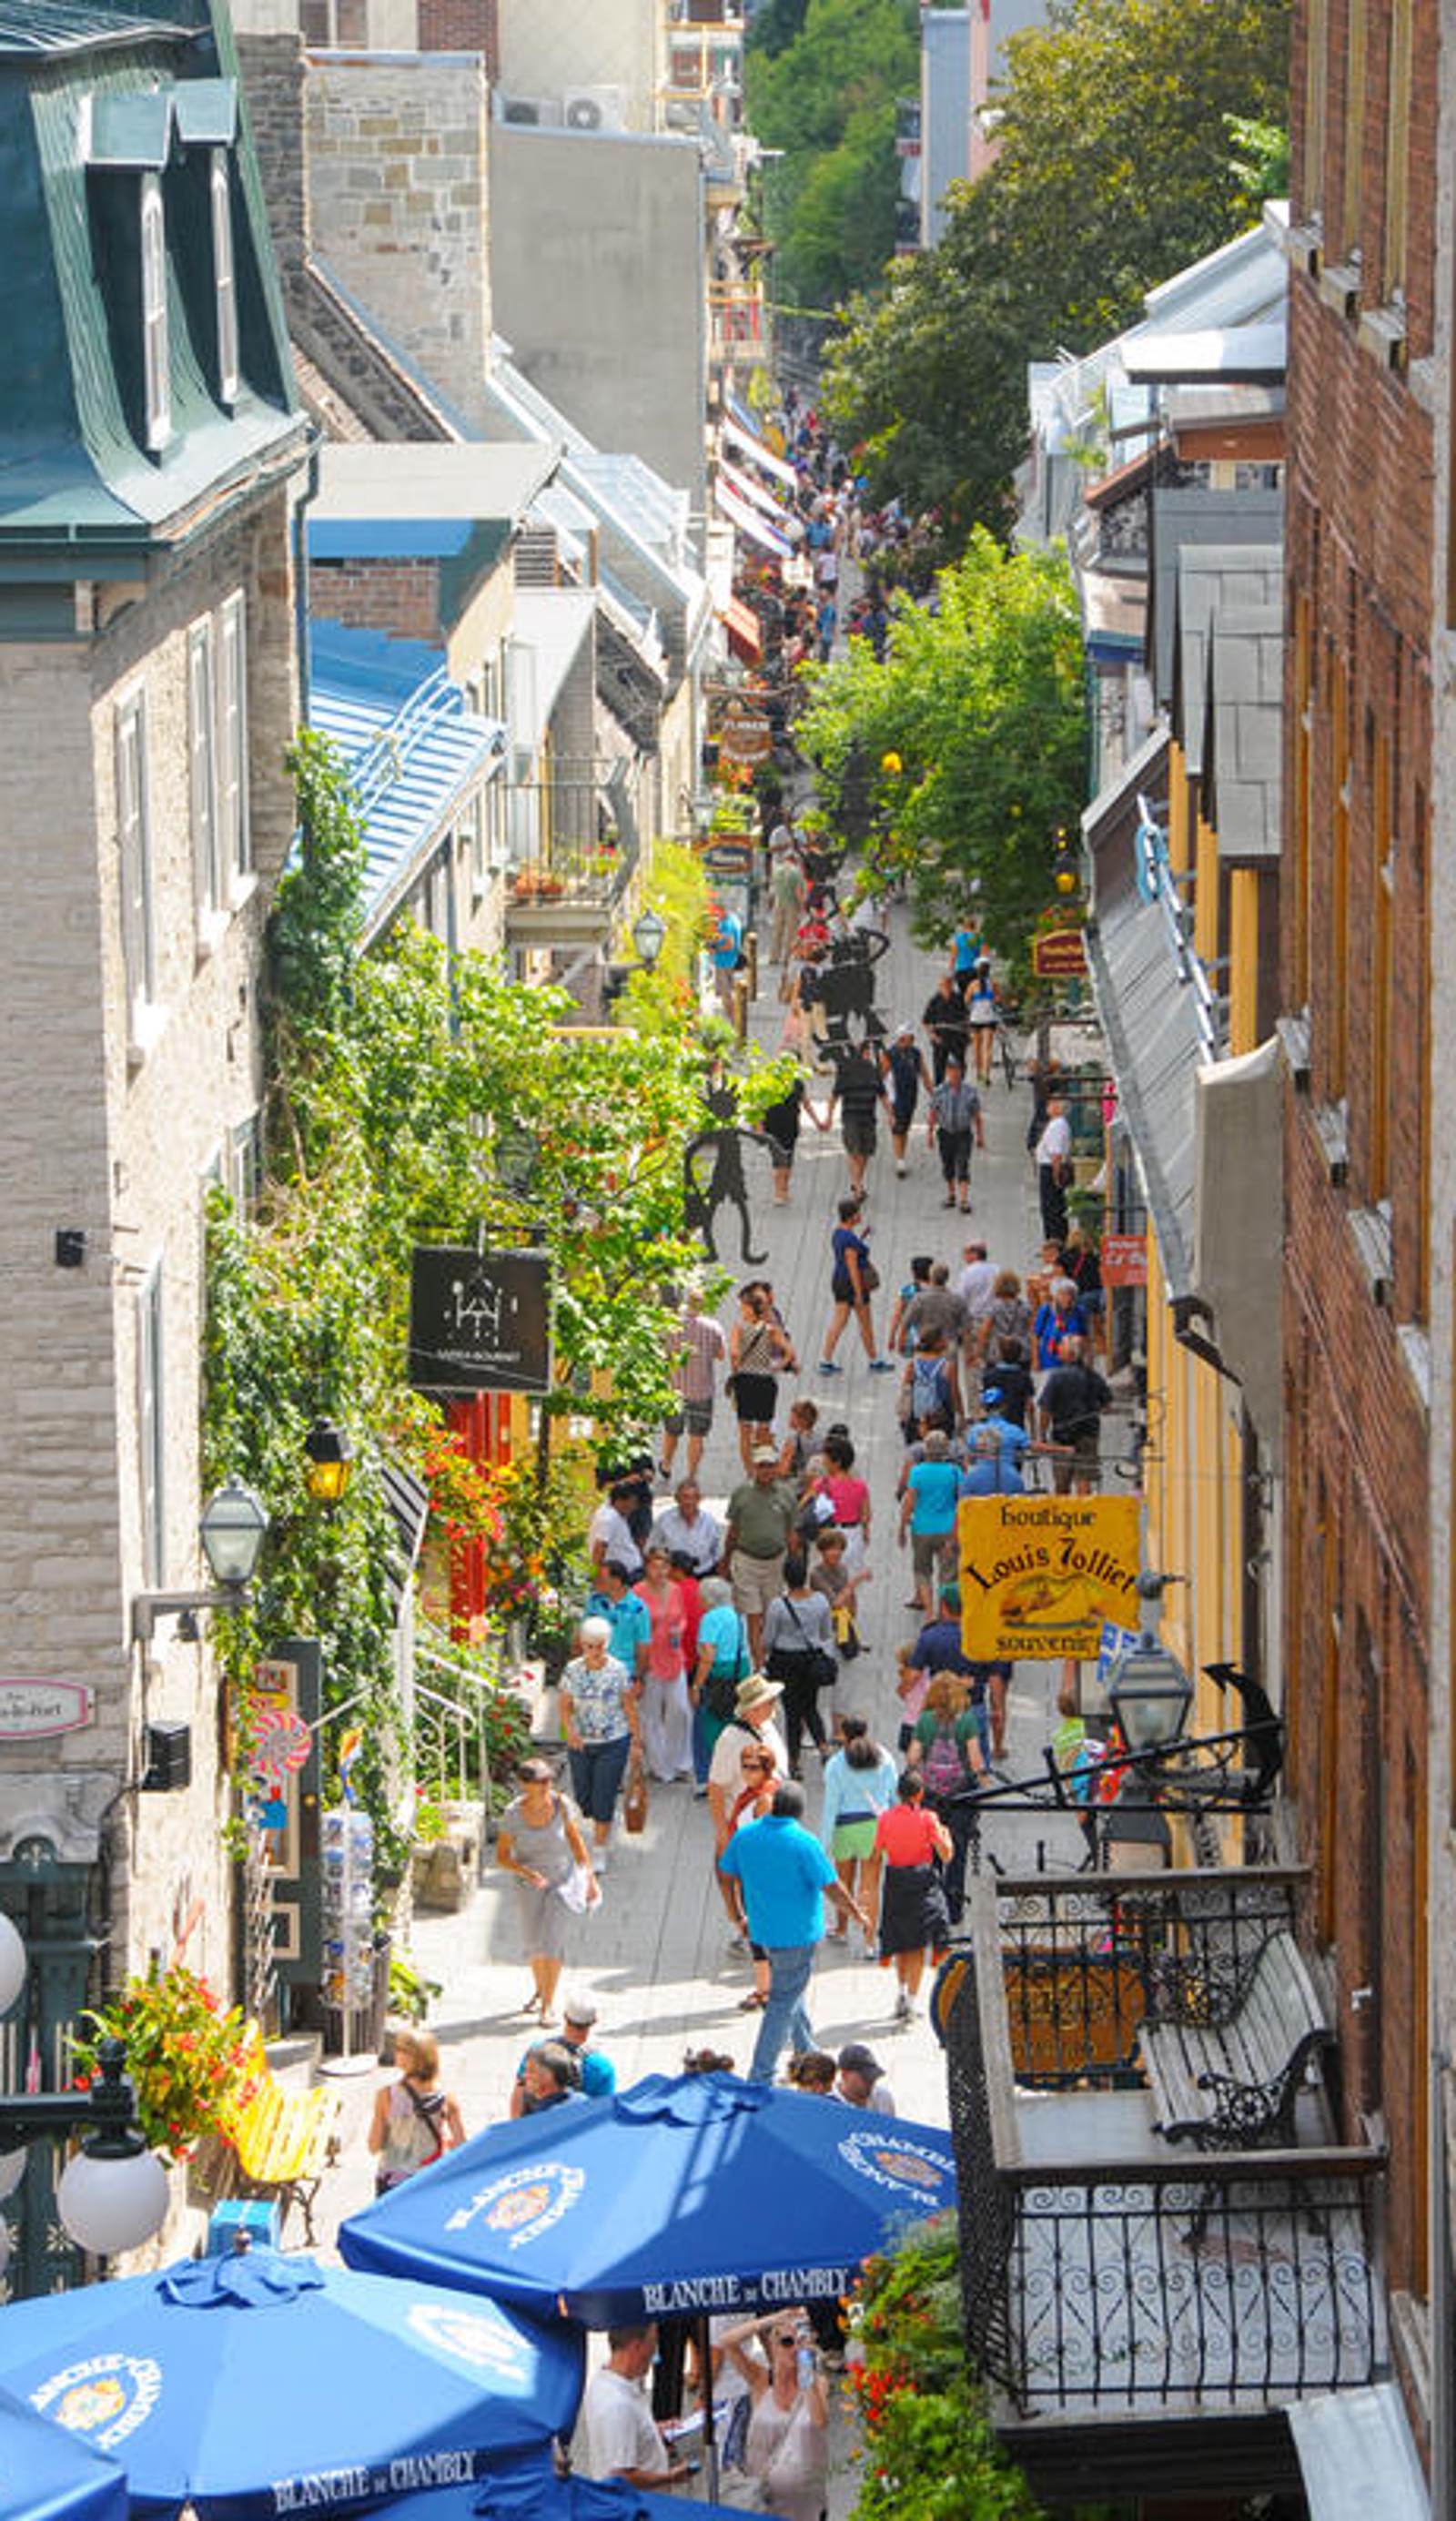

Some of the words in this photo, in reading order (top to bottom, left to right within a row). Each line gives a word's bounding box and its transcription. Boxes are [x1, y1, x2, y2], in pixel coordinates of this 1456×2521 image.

[1001, 1503, 1097, 1532] boutique
[966, 1544, 1049, 1591] Louis
[642, 2274, 742, 2313] BLANCHE
[761, 2266, 848, 2302] CHAMBLY
[272, 2465, 369, 2514] BLANCHE
[389, 2449, 477, 2491] CHAMBLY
